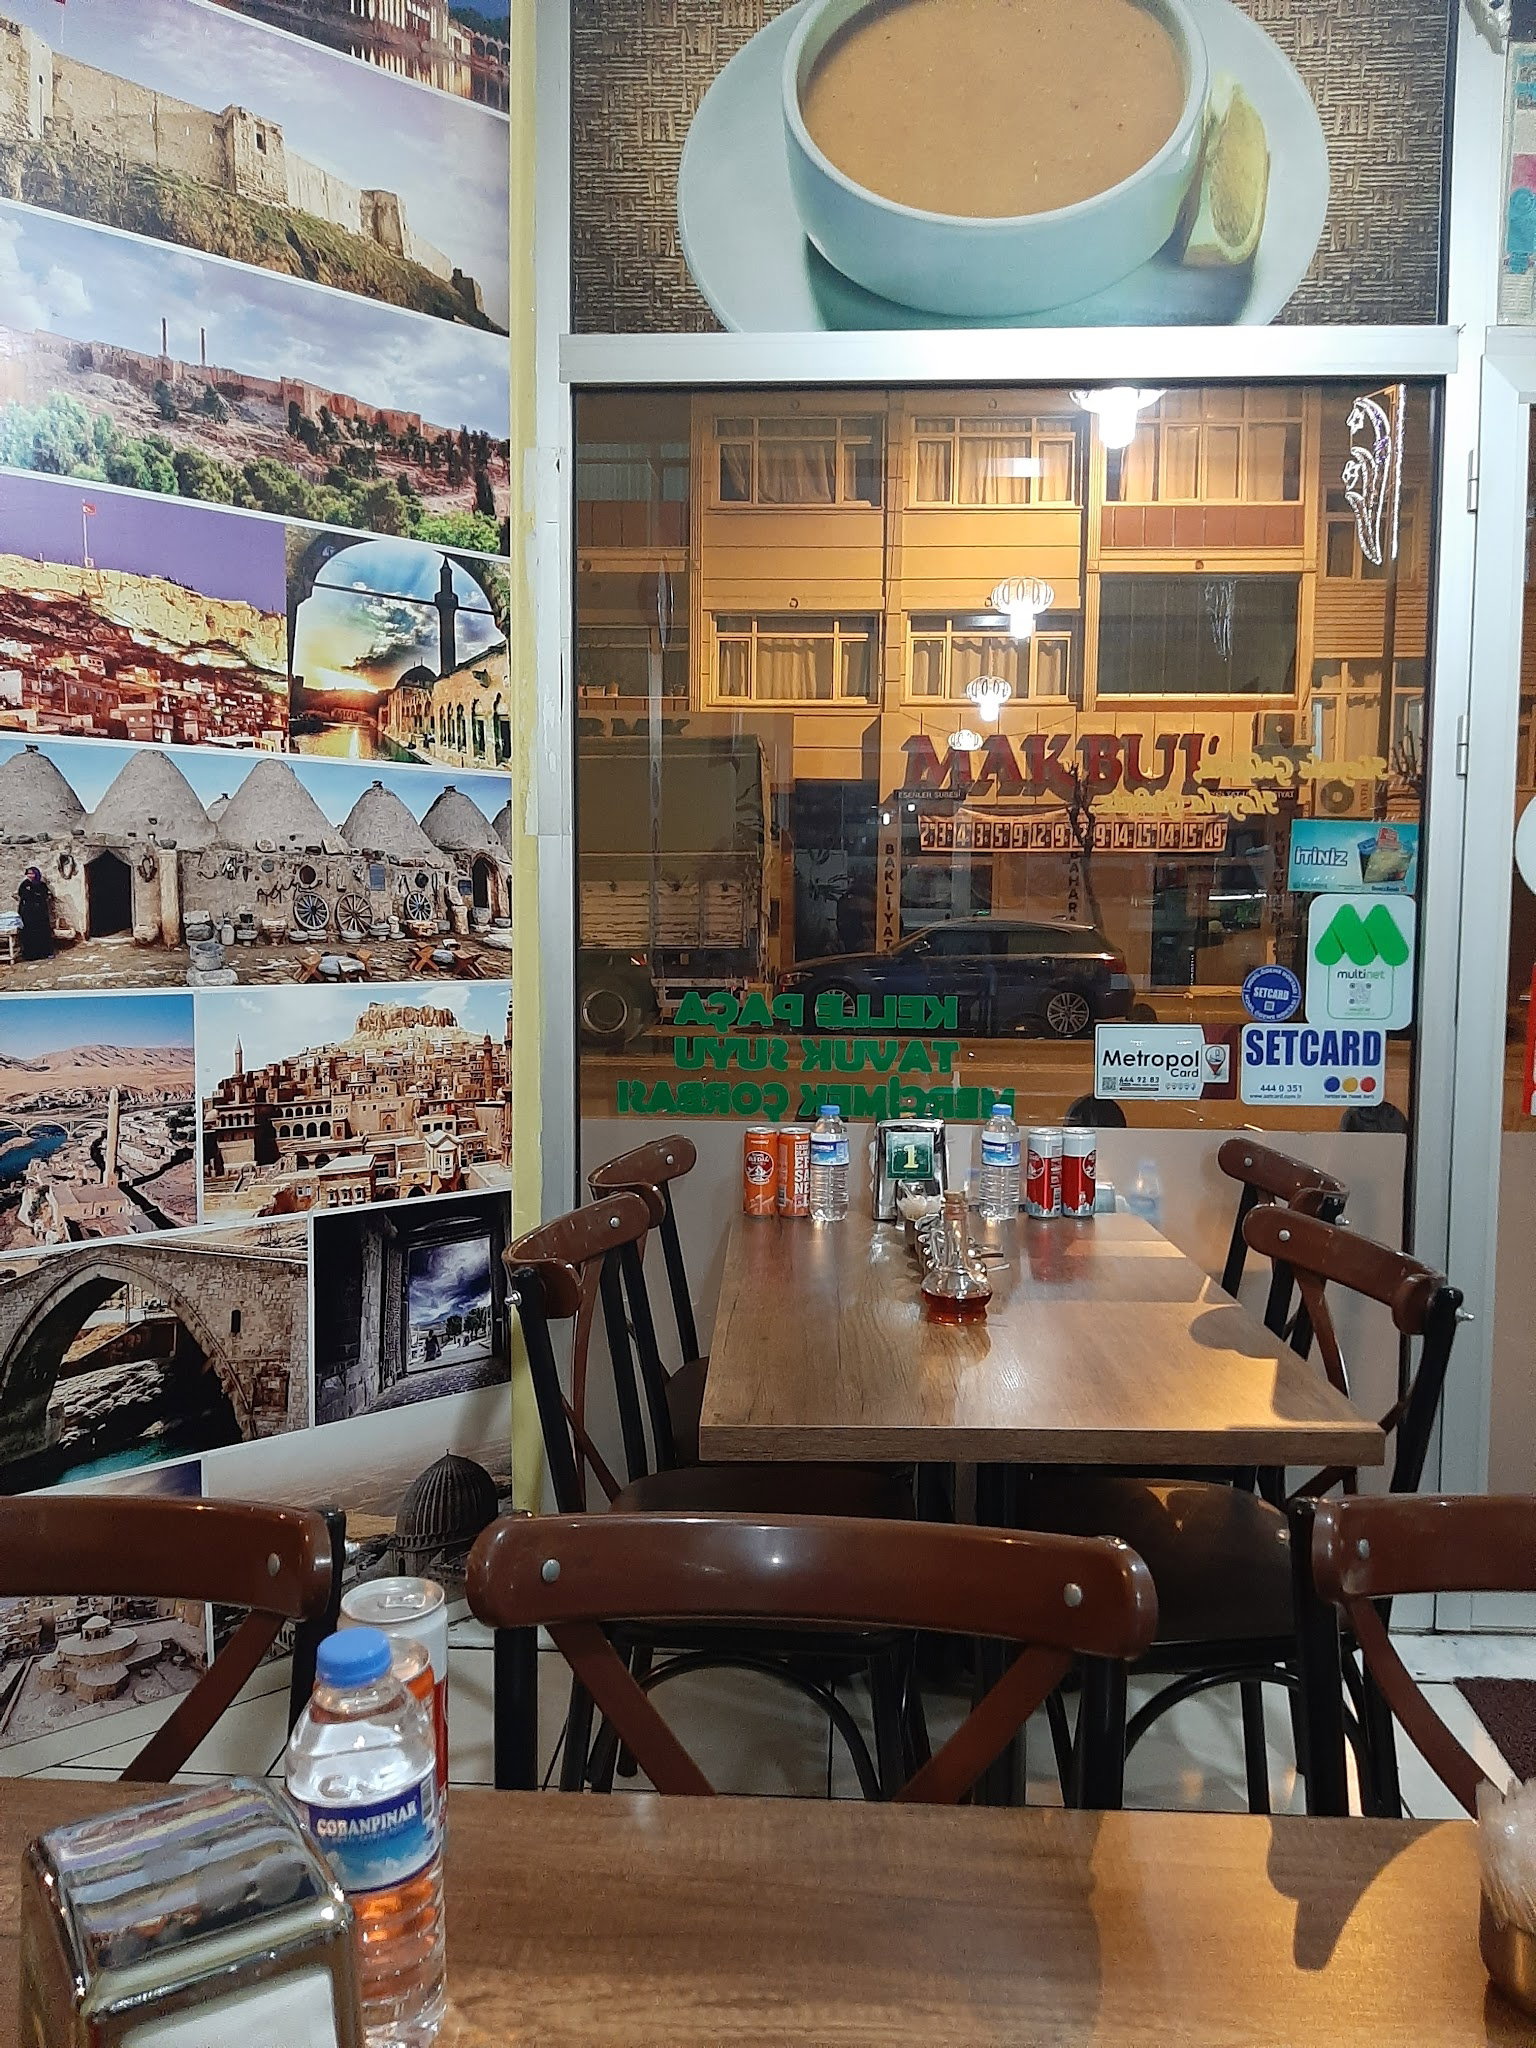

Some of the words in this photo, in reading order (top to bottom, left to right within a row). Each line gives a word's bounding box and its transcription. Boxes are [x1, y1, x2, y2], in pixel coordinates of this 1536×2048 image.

[1336, 968, 1386, 979] multinet
[1253, 986, 1290, 1001] SETCARD
[1246, 1029, 1381, 1066] SETCARD
[1103, 1050, 1200, 1071] Metropol
[1171, 1068, 1200, 1078] Card
[1260, 1084, 1276, 1092] 444
[1278, 1084, 1285, 1092] 0
[1287, 1084, 1302, 1092] 351
[903, 1144, 919, 1169] 1
